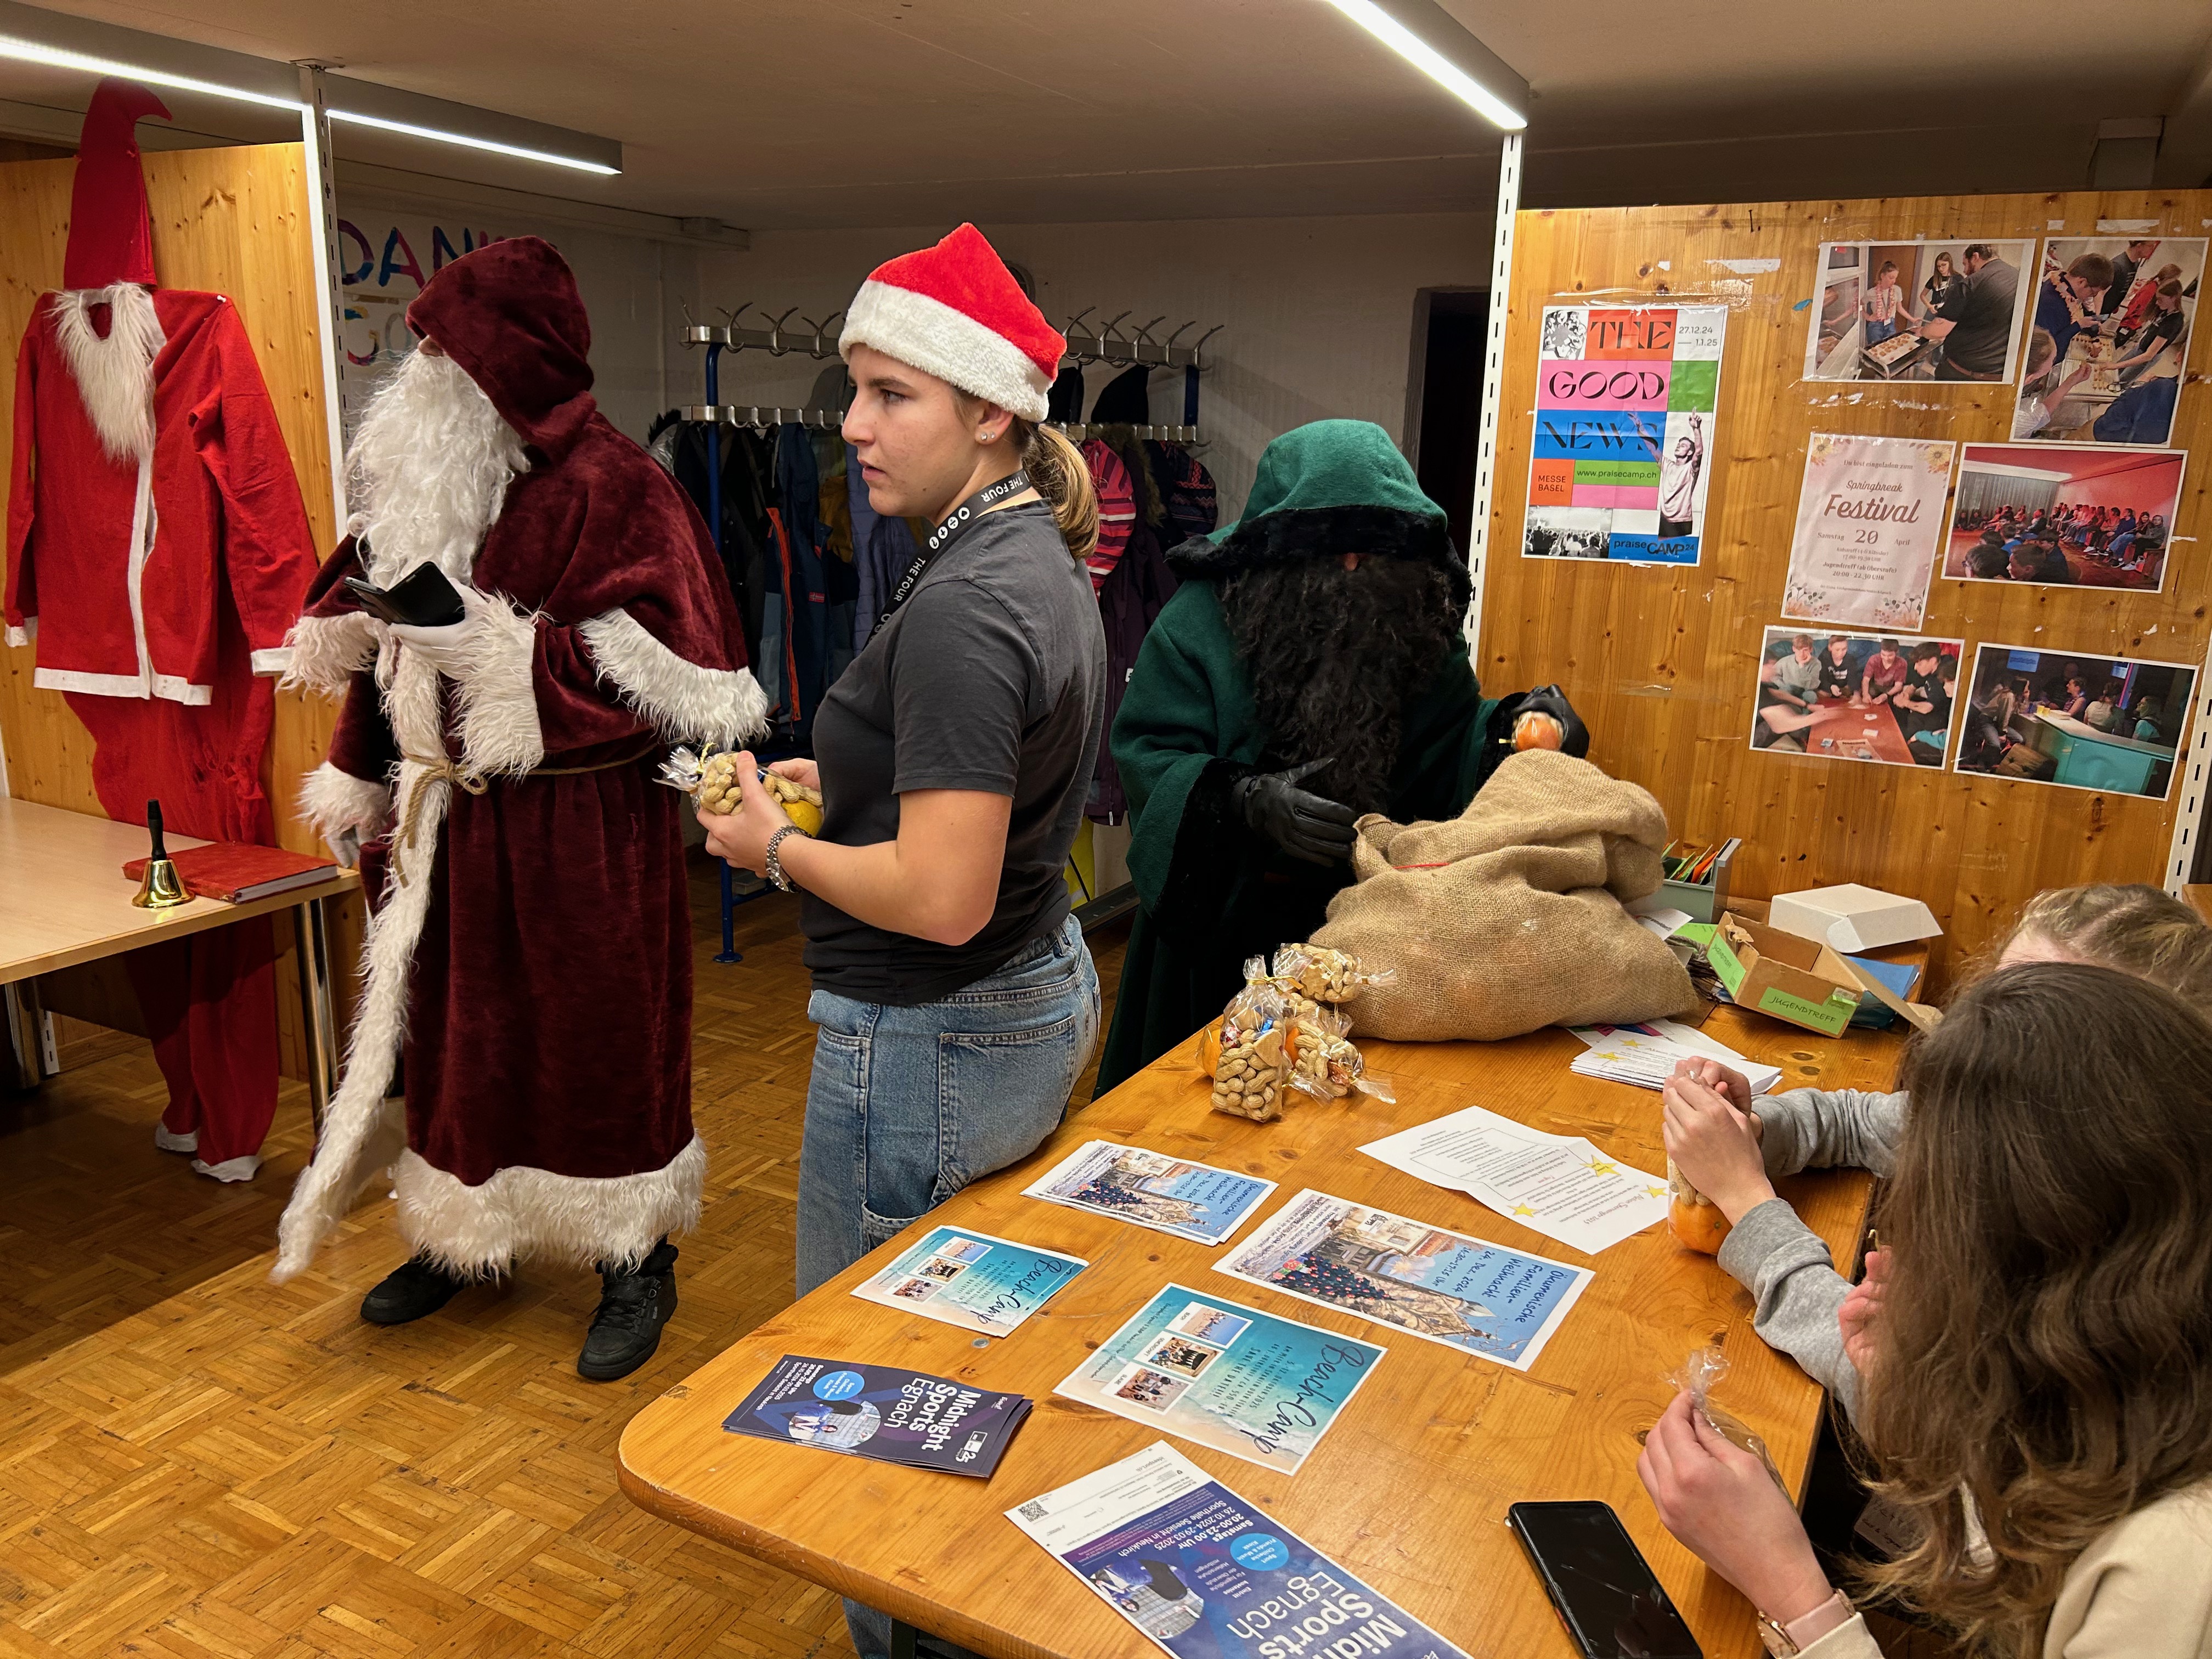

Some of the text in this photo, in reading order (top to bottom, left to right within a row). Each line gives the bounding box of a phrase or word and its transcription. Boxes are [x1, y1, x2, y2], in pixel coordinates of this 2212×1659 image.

[1590, 320, 1671, 349] THE
[1695, 338, 1718, 347] 1.1.25
[1549, 371, 1664, 400] GOOD
[1542, 421, 1659, 451] NEWS
[1577, 470, 1657, 479] www.praisecamp.ch
[1866, 461, 1898, 470] eingeladen
[981, 476, 1024, 503] THE FOUR
[1538, 475, 1566, 484] MESSE
[1538, 483, 1565, 493] BASEL
[1846, 480, 1903, 493] Springbreak
[1824, 494, 1921, 523] Festival
[1818, 529, 1910, 546] Samstag 20 April
[894, 557, 926, 602] THE FOUR
[1768, 996, 1837, 1023] JUGENDTREFF
[1430, 1276, 1446, 1287] Uhr
[1451, 1250, 1495, 1294] 24. Dez. 2024
[1481, 1257, 1525, 1299] Weihnacht
[1502, 1263, 1545, 1305] Familien-
[970, 1259, 1062, 1324] Beach-Camp
[1514, 1269, 1569, 1327] Ökumenische
[1208, 1347, 1261, 1398] SAVE THE DATE!!!
[1259, 1374, 1283, 1396] OKTOBER
[882, 1378, 935, 1428] Egnach
[907, 1384, 958, 1432] Sports
[1239, 1344, 1365, 1454] Beach-Camp
[1248, 1395, 1266, 1409] 2025
[921, 1390, 981, 1452] Midnight
[1117, 1499, 1228, 1558] Sporthalle Seesicht in Neukirch
[1211, 1519, 1255, 1543] Samstags
[1175, 1538, 1197, 1550] Uhr
[1235, 1550, 1254, 1561] Music
[1240, 1540, 1259, 1550] Kiosk
[1254, 1538, 1277, 1550] Friends
[1259, 1553, 1278, 1564] Sport
[1203, 1572, 1231, 1586] Oberstufe
[1221, 1580, 1250, 1595] kostenlos
[1230, 1586, 1253, 1598] Eintritt
[1226, 1571, 1346, 1639] Egnach
[1256, 1591, 1379, 1659] Sports
